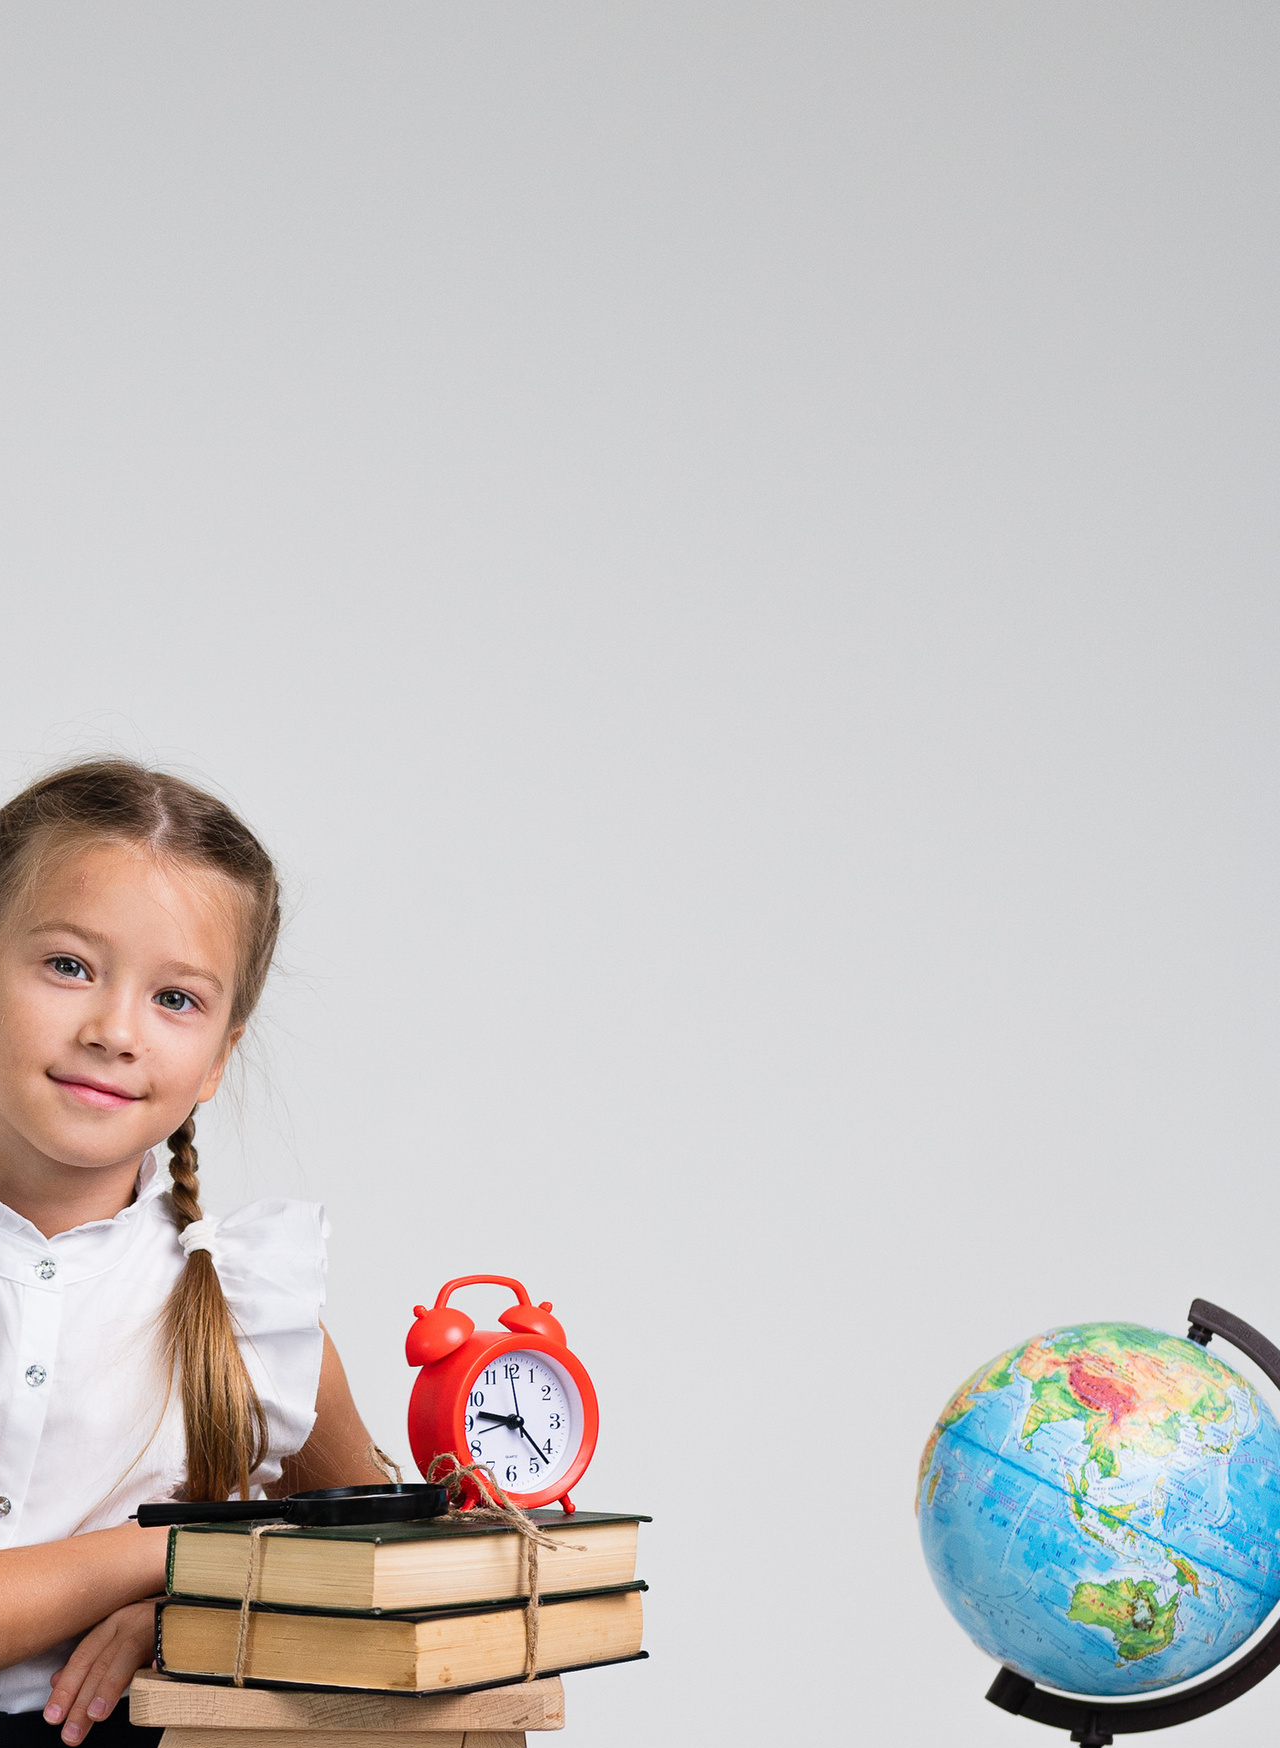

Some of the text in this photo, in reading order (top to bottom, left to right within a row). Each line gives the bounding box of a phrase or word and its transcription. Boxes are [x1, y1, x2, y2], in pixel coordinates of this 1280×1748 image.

[484, 1369, 496, 1385] 11
[503, 1363, 520, 1379] 12
[528, 1368, 535, 1383] 1
[469, 1391, 484, 1407] 10
[541, 1385, 551, 1400] 2
[465, 1415, 474, 1432] 9
[549, 1413, 560, 1429] 3
[470, 1440, 482, 1457] 8
[542, 1438, 553, 1454] 4
[528, 1457, 539, 1473] 5
[506, 1465, 517, 1482] 6
